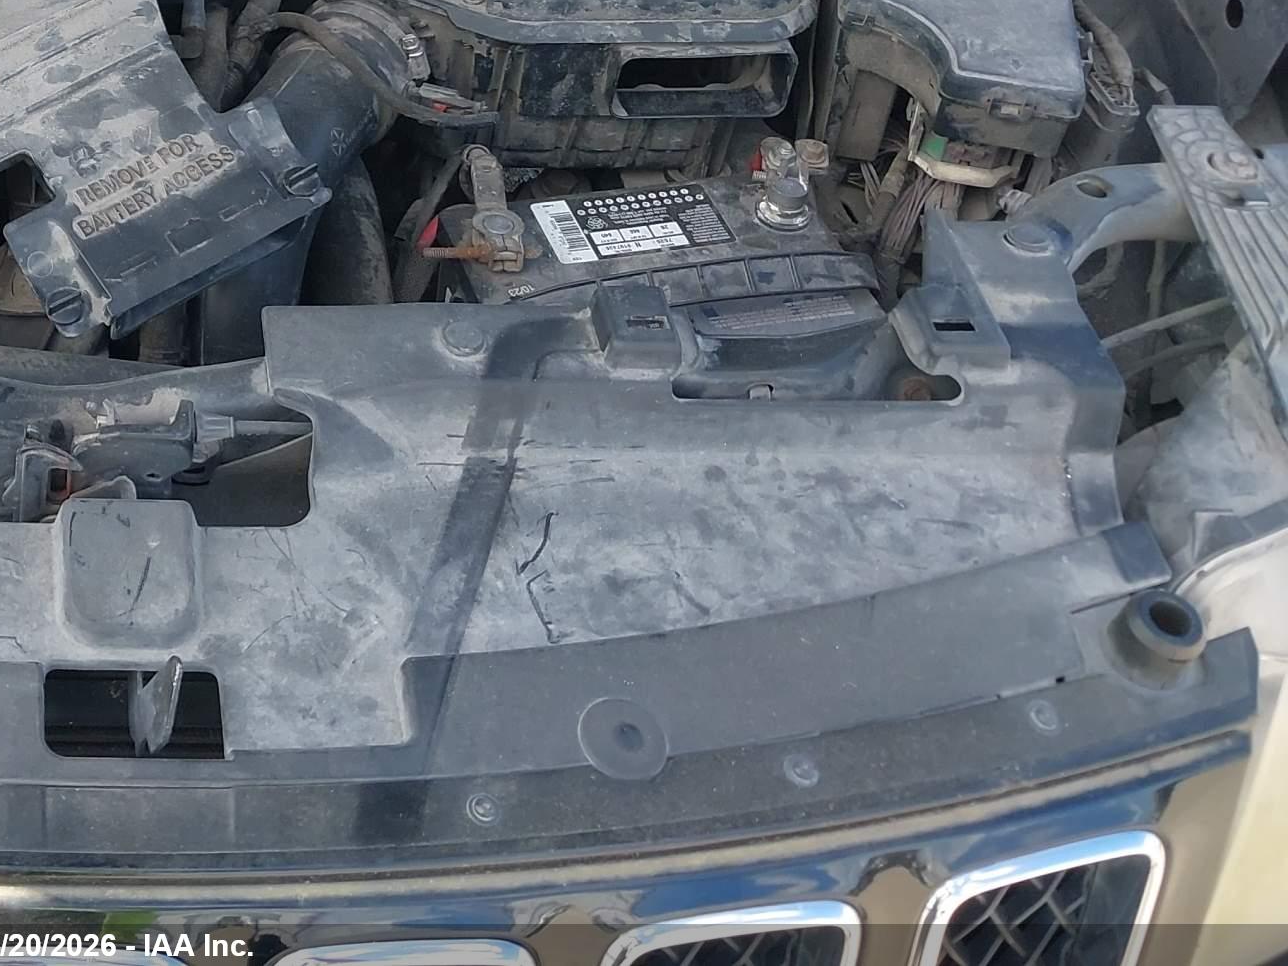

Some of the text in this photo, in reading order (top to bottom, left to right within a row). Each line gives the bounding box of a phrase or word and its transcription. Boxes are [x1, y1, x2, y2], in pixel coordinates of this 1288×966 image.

[76, 134, 204, 206] REMOVE FOR
[76, 146, 235, 237] BATTERY ACCESS
[508, 284, 535, 297] 10/23
